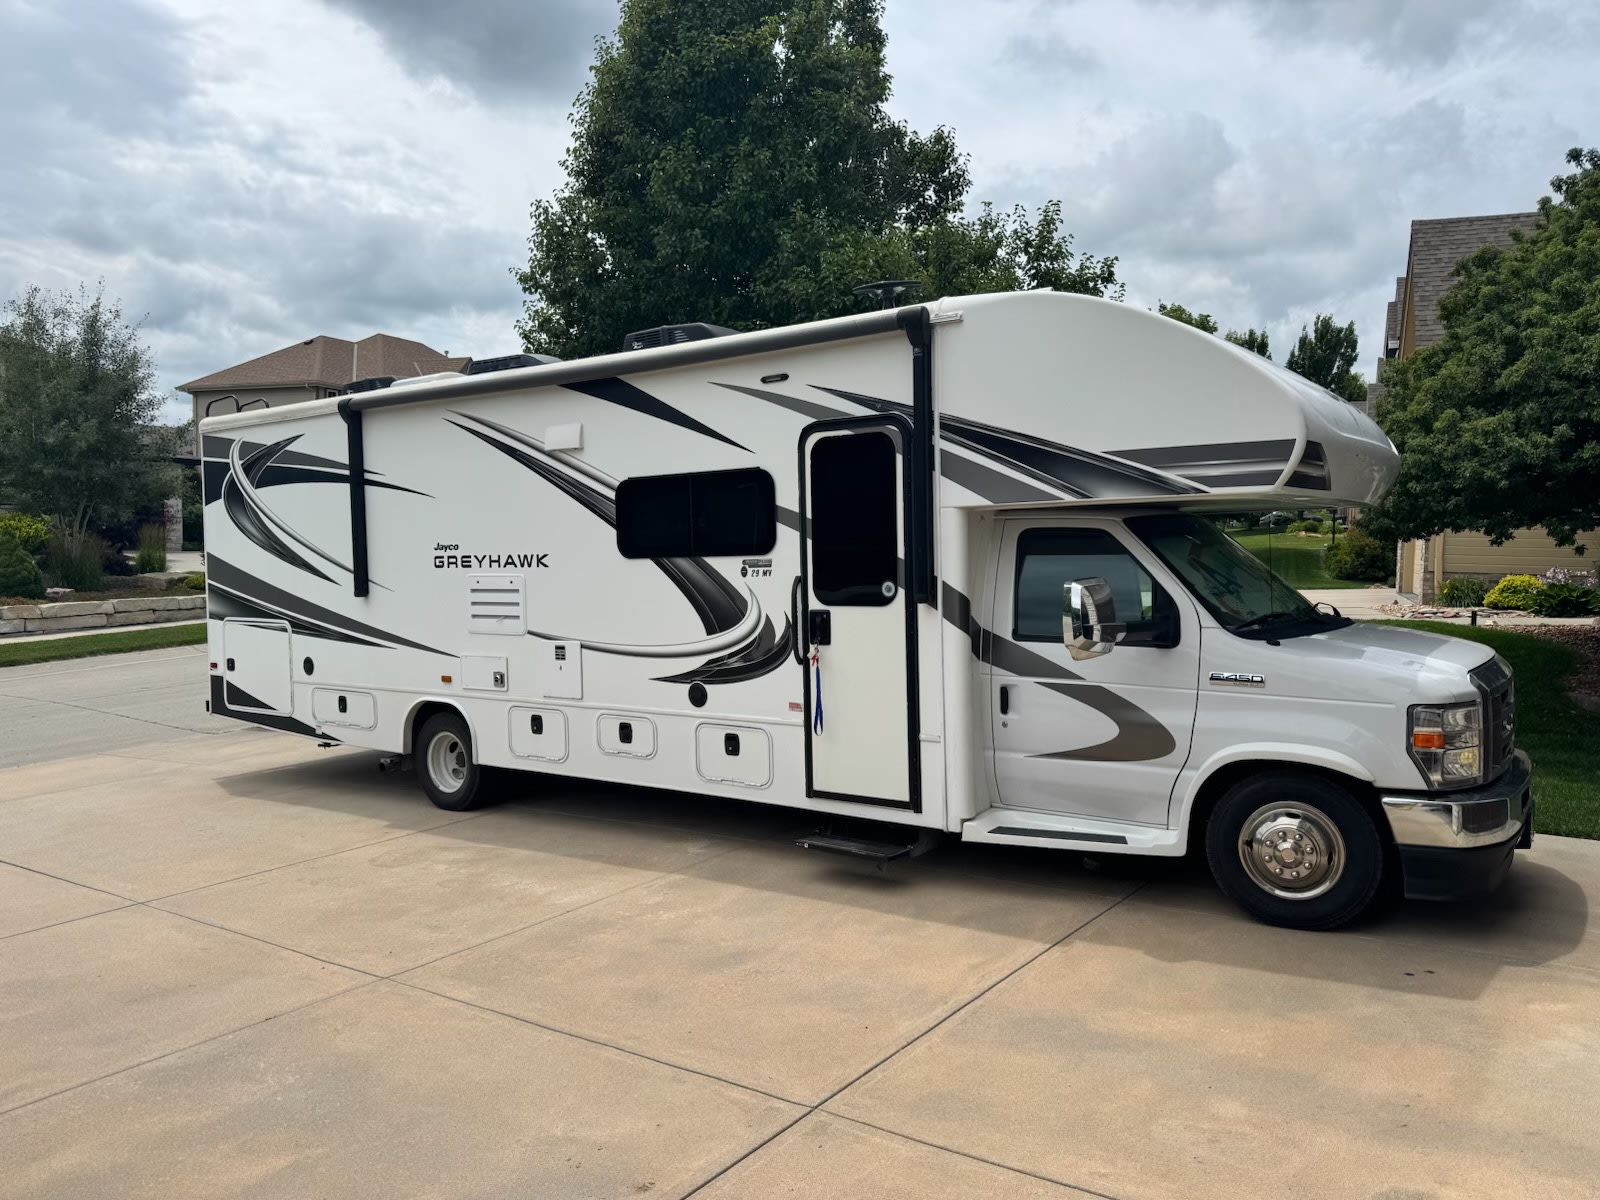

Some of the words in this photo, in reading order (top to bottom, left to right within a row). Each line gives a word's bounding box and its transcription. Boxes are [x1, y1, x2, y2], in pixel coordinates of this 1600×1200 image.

[434, 542, 459, 553] Jayco
[434, 554, 549, 568] GREYHAWK
[751, 569, 760, 577] 29
